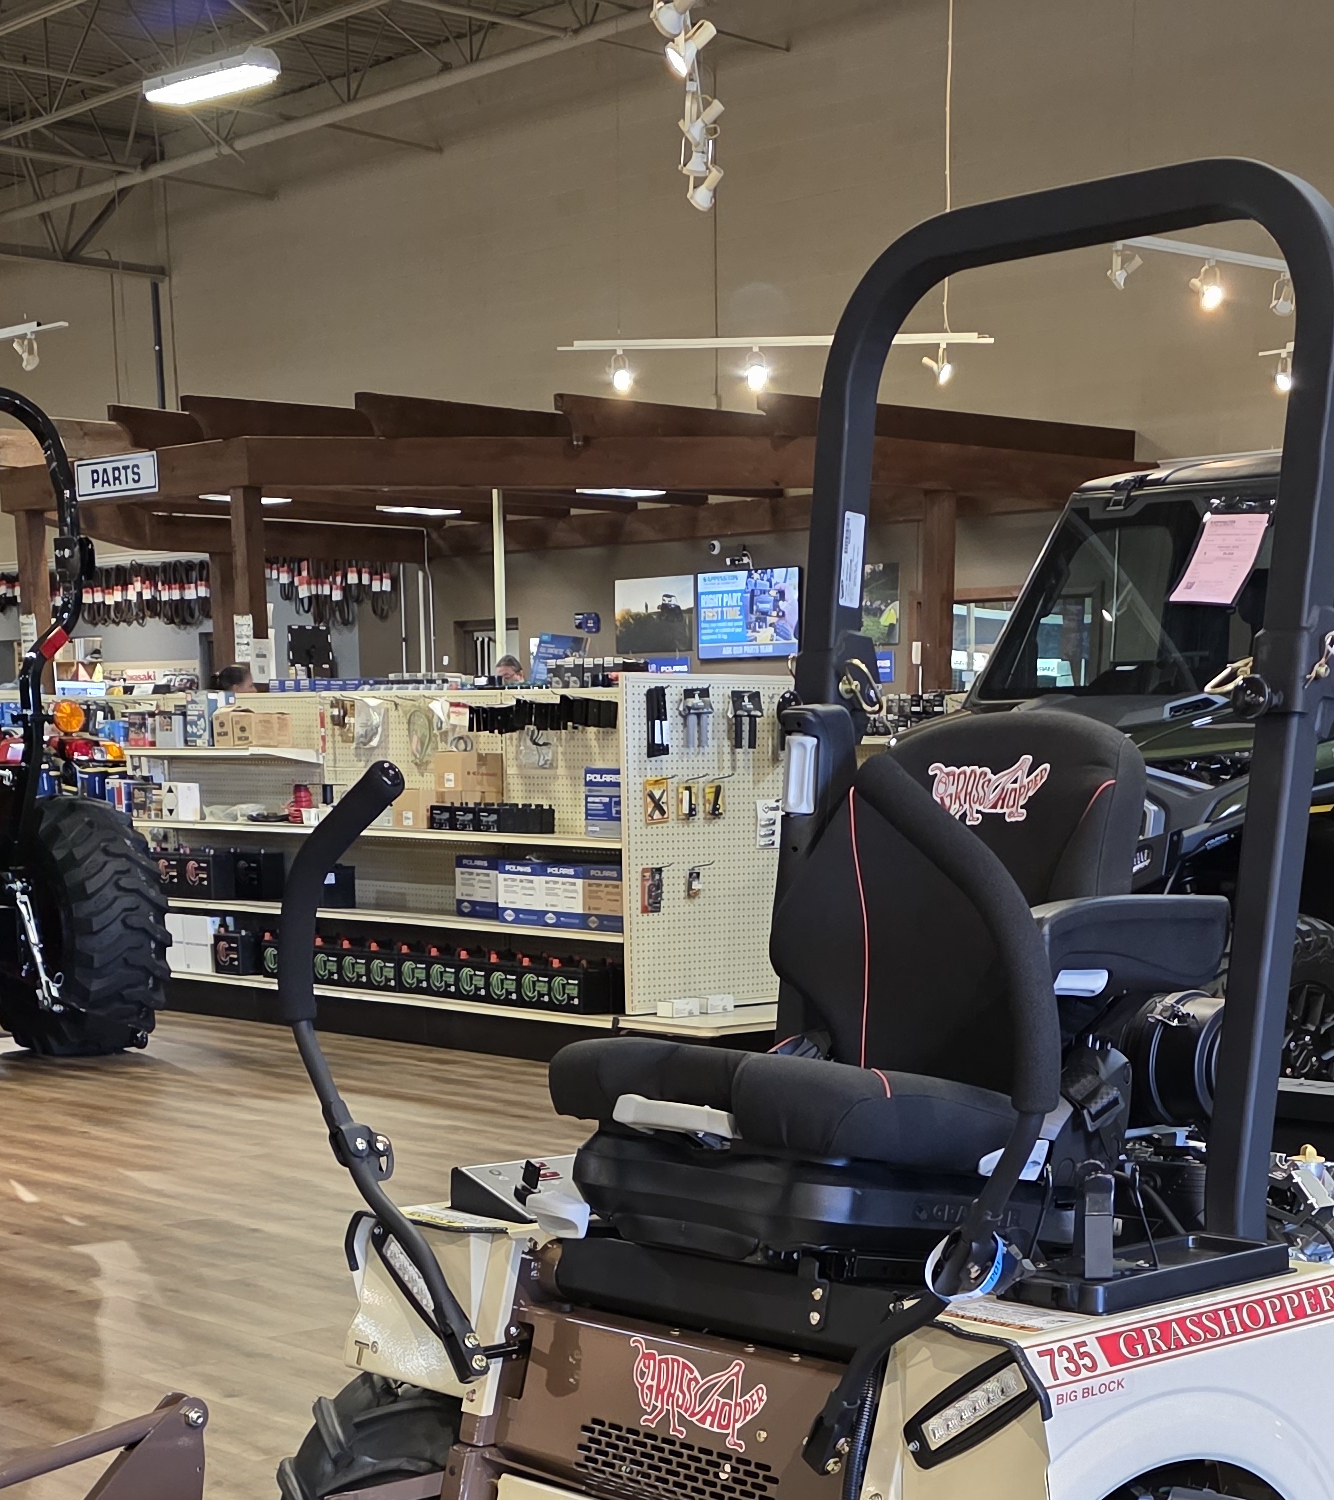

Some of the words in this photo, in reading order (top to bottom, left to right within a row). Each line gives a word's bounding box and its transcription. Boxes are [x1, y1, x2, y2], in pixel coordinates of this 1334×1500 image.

[90, 463, 142, 490] PARTS
[701, 594, 722, 607] RIGHT
[505, 864, 532, 873] POLARIS
[547, 867, 575, 876] POLARIS
[1037, 1340, 1100, 1382] 735
[631, 1344, 767, 1438] GRASSHOPPER
[1056, 1386, 1079, 1406] BIG
[1081, 1377, 1125, 1402] BLOCK
